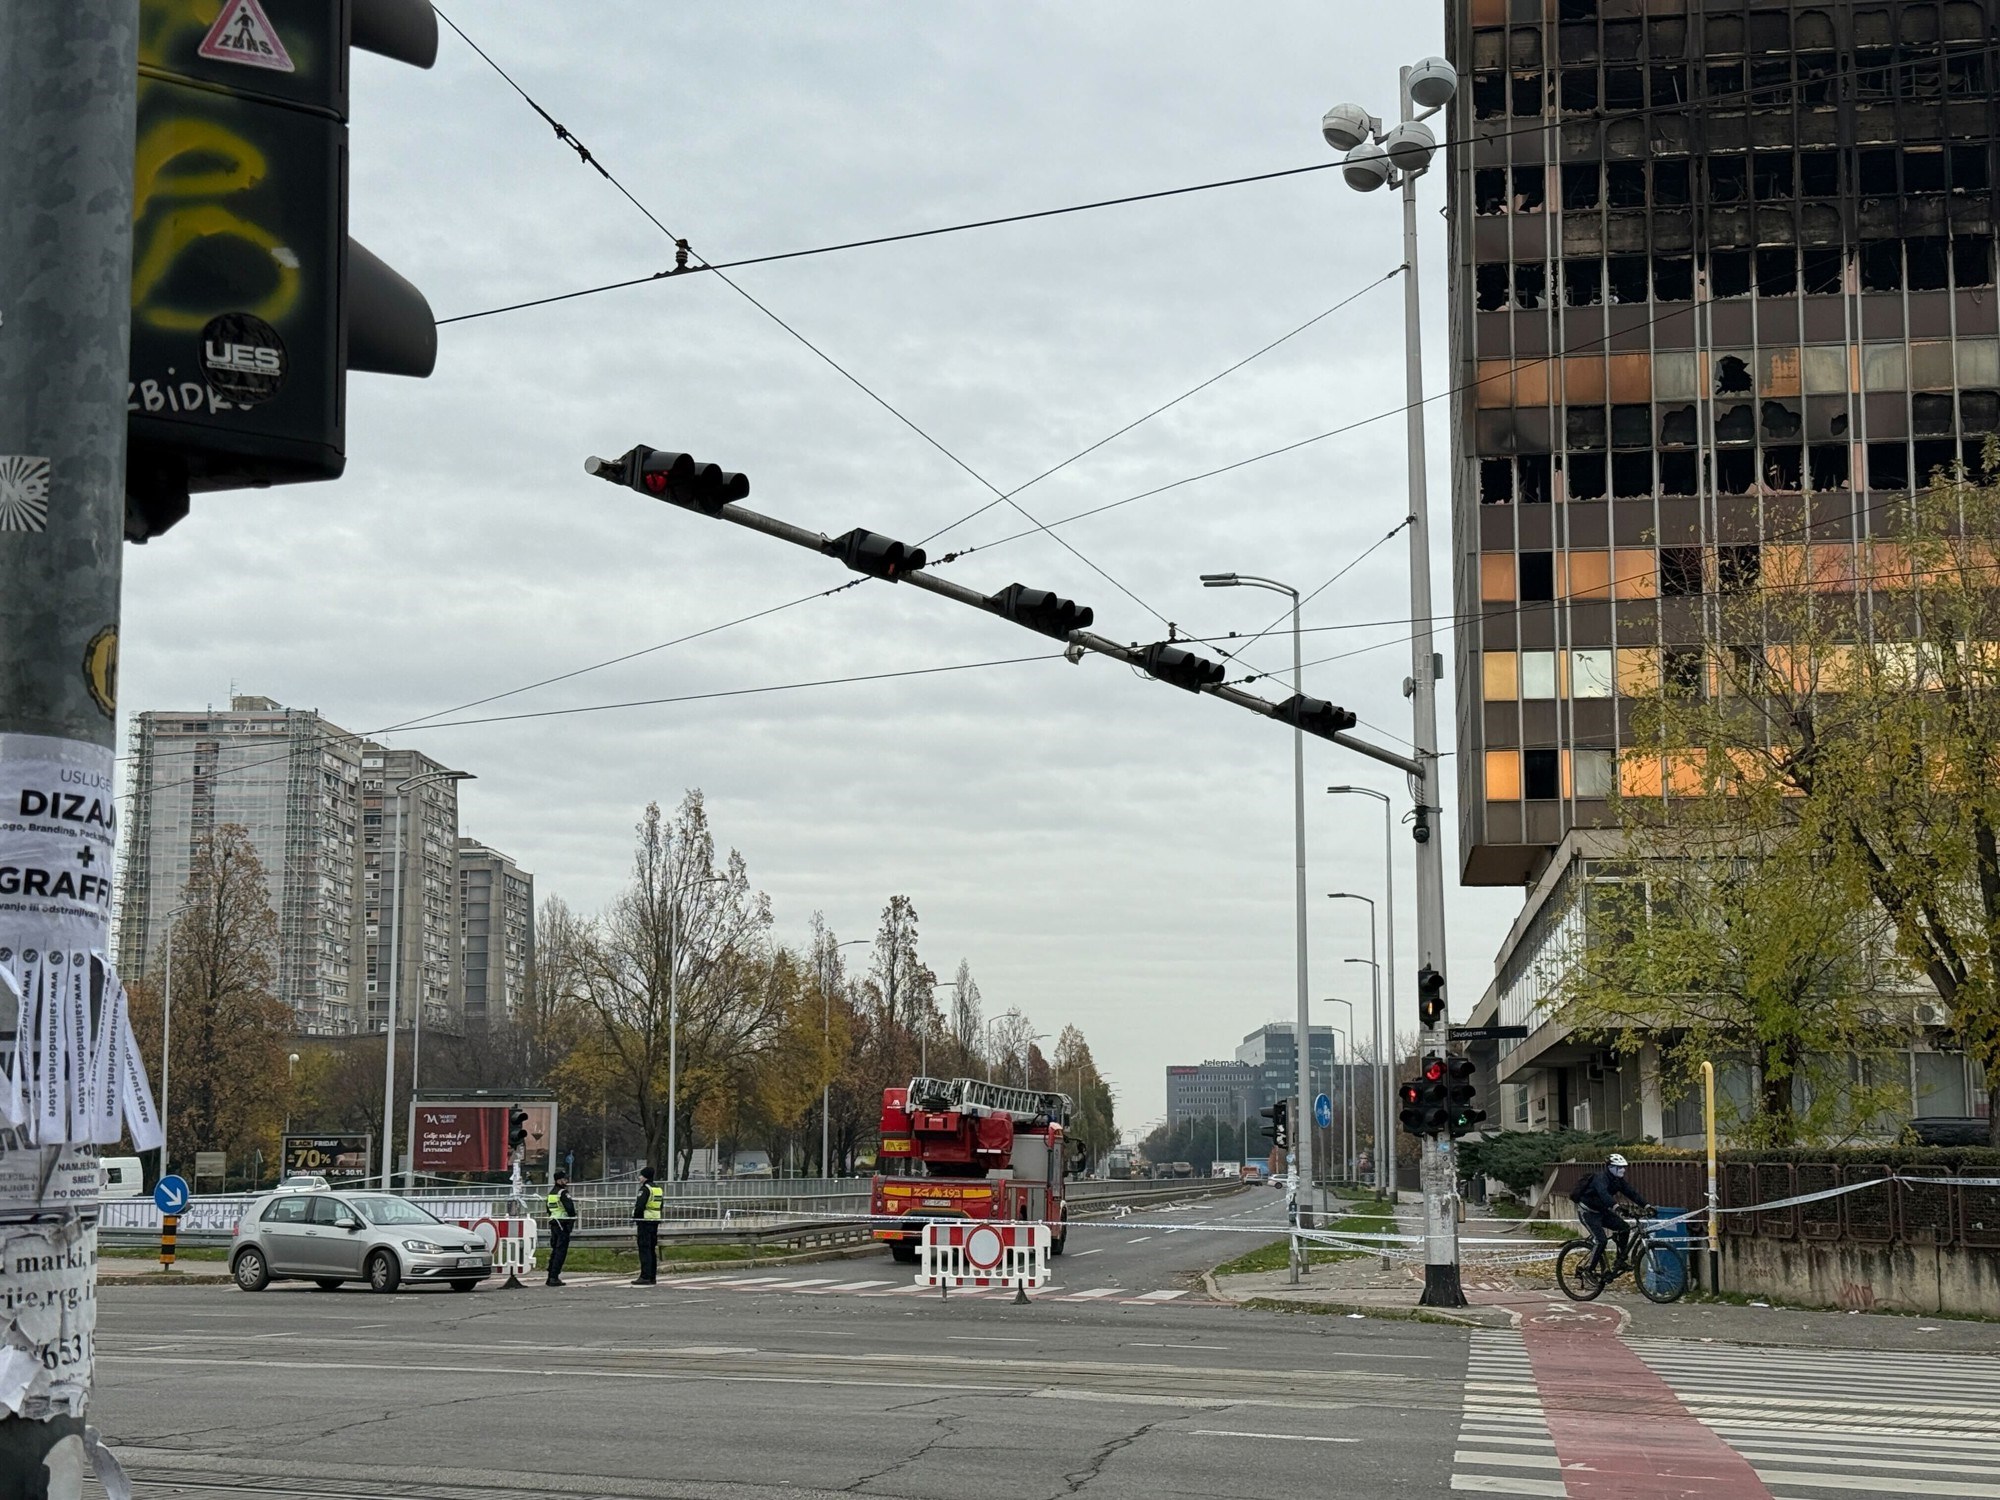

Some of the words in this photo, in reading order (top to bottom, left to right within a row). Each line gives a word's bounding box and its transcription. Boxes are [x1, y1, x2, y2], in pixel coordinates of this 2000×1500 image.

[205, 340, 280, 369] UES
[28, 823, 78, 837] Branding,
[1452, 1030, 1472, 1038] Savska
[48, 971, 60, 1118] www.saintandorient.store
[74, 973, 87, 1115] www.saintandorient.store
[1203, 1059, 1246, 1067] telemach
[287, 1169, 309, 1177] Family
[53, 1190, 67, 1199] PO
[942, 1188, 960, 1199] 193
[16, 1246, 87, 1274] marki,
